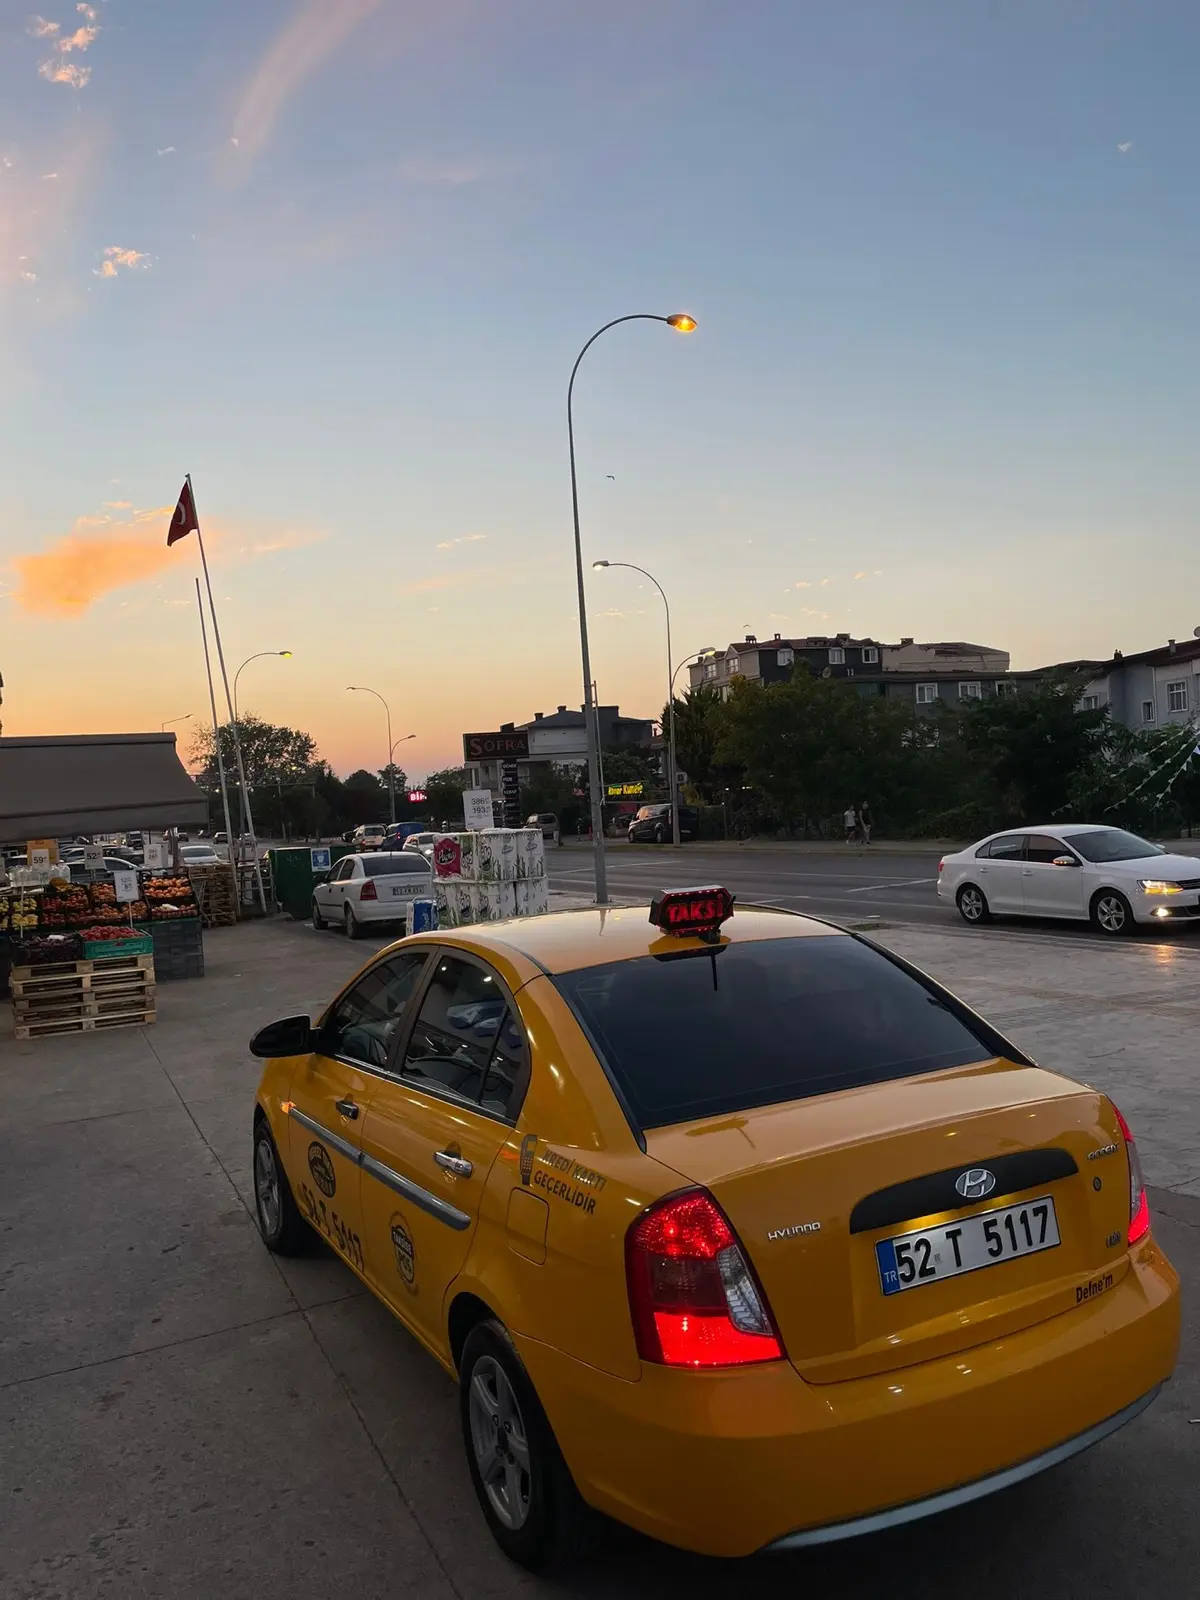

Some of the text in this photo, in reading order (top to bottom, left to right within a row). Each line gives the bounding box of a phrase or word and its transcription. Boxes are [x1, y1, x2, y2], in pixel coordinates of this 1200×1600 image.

[469, 738, 527, 756] SOFRA
[668, 893, 723, 923] TAKSİ
[534, 1170, 596, 1214] GEÇERLİDİR
[895, 1204, 1048, 1283] 52 T 5117
[884, 1270, 898, 1283] TR
[1076, 1273, 1114, 1303] Defne'm
